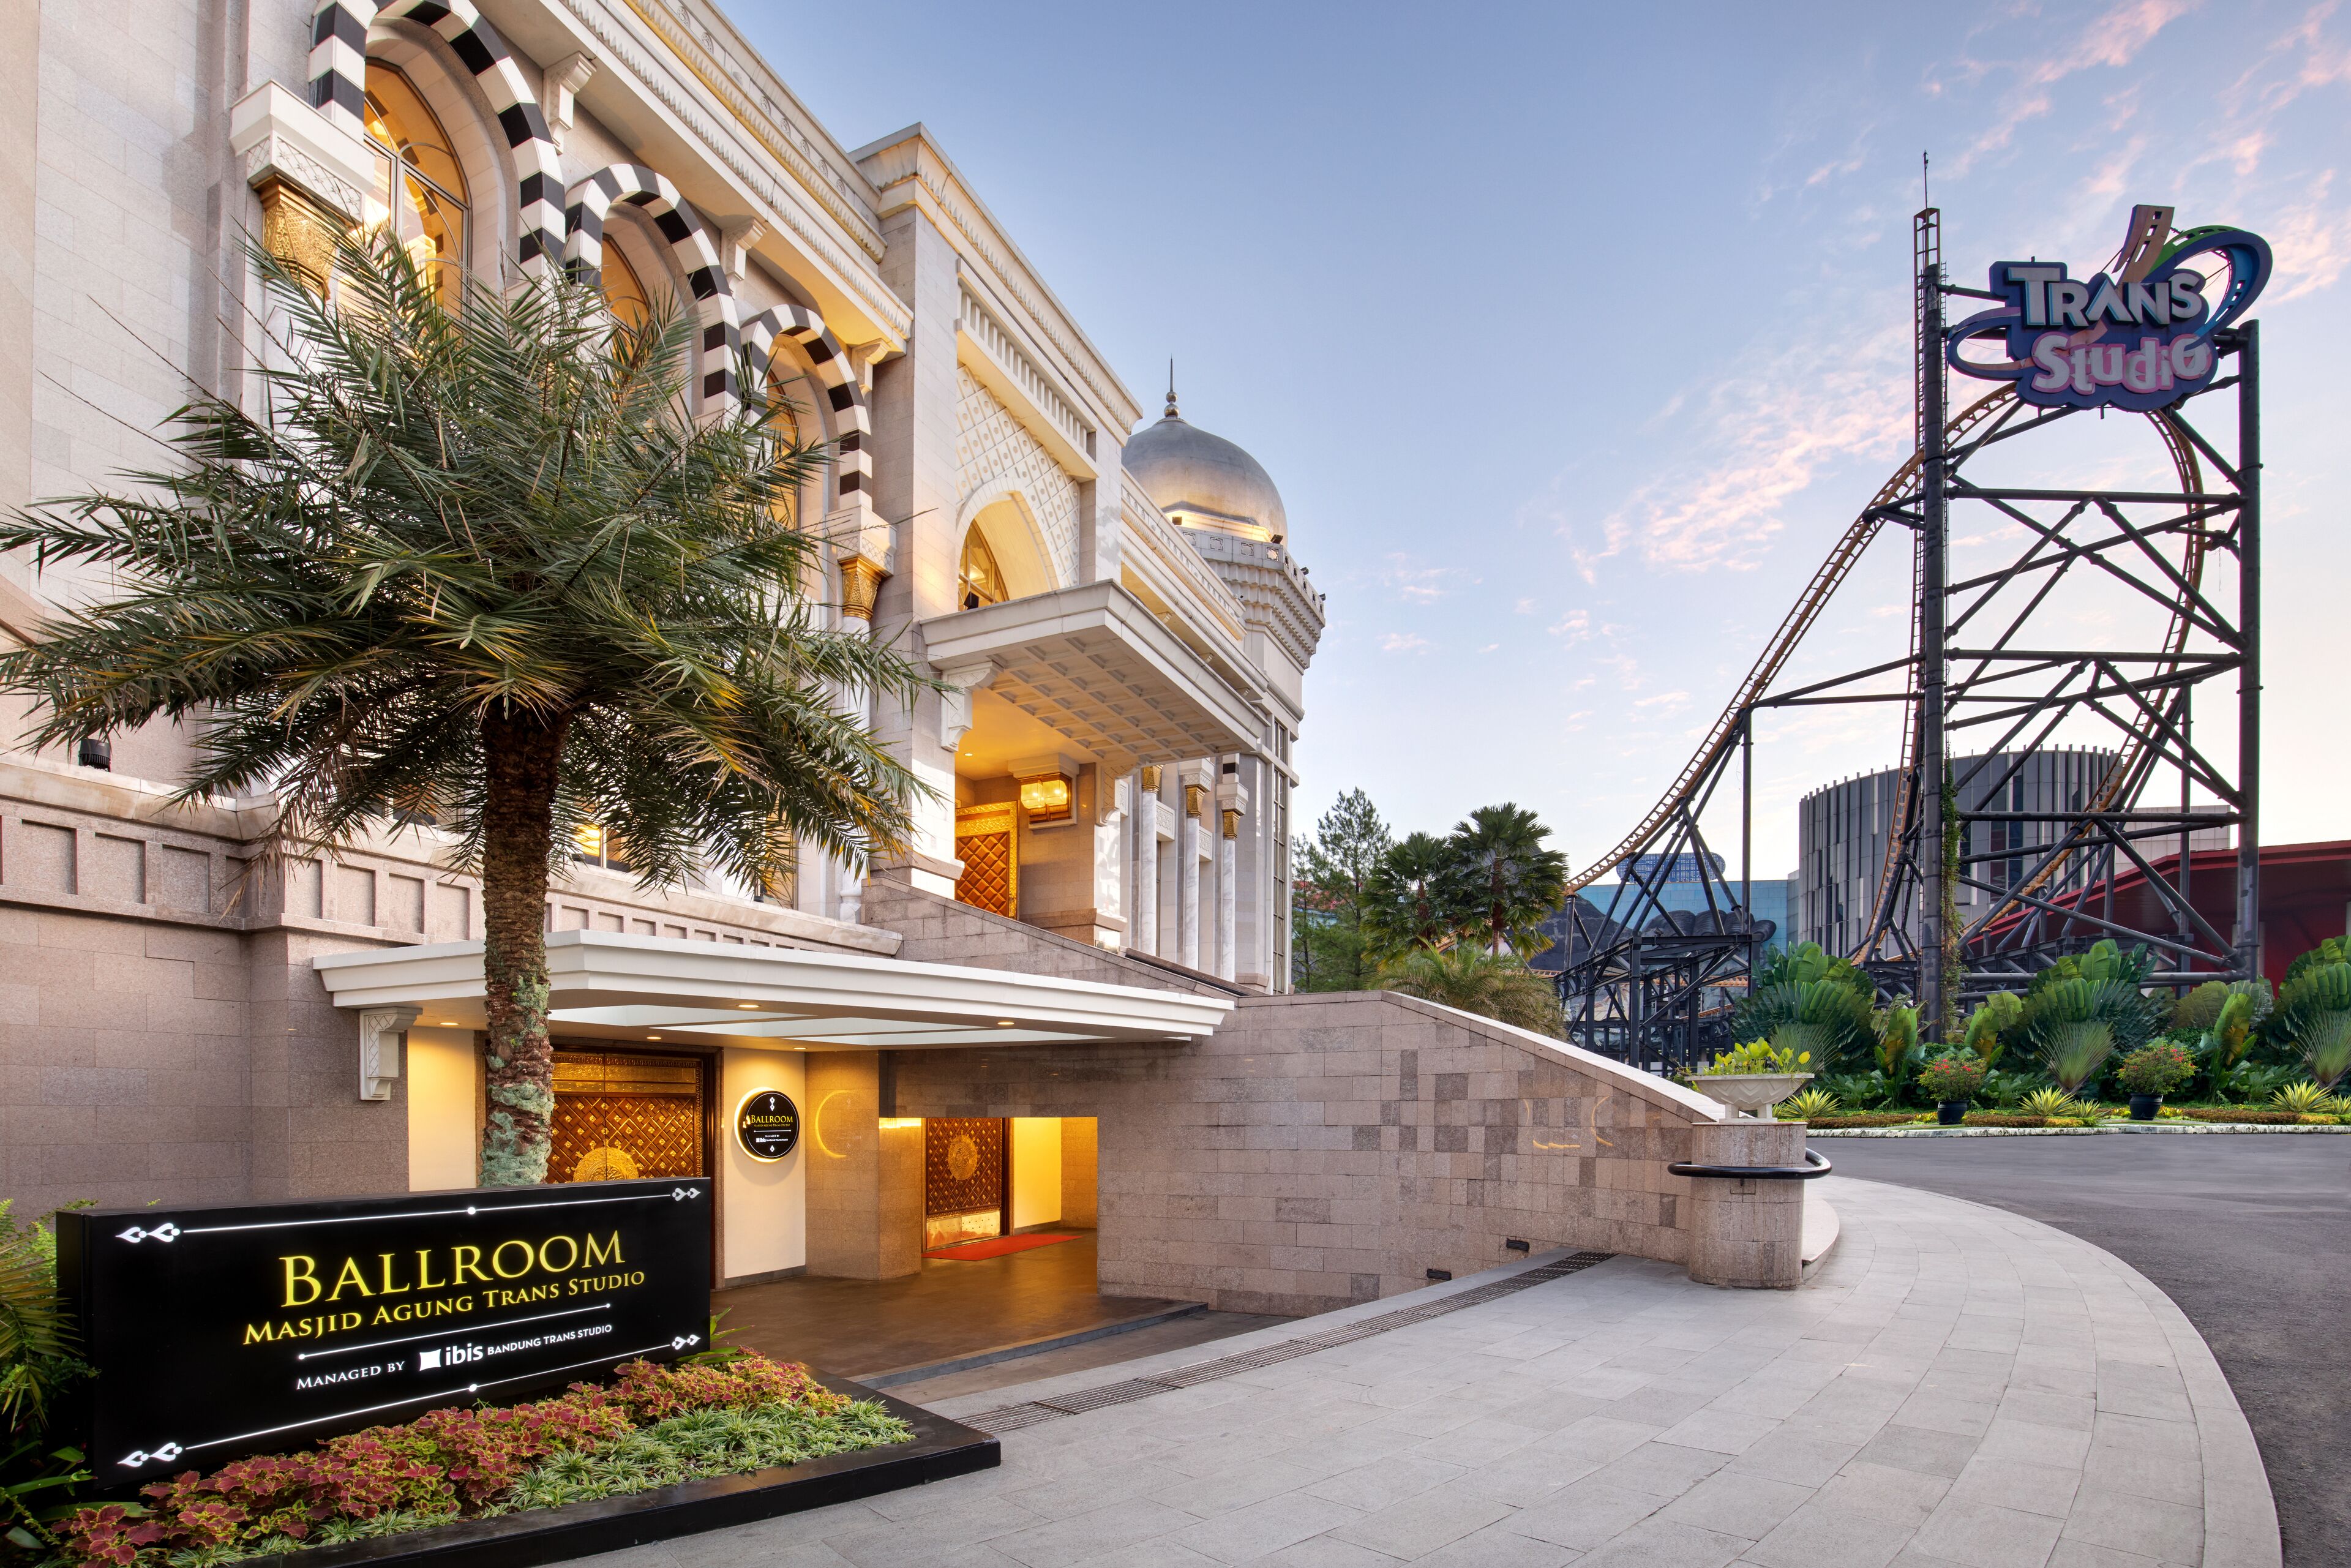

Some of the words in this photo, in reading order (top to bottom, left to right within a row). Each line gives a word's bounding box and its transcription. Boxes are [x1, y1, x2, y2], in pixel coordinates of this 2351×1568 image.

[2008, 267, 2203, 328] TRANS
[2032, 332, 2212, 394] Studio
[751, 1114, 793, 1123] BALLROOM
[279, 1230, 626, 1307] BALLROOM
[242, 1312, 362, 1345] MASJID
[371, 1296, 473, 1326] AGUNG
[482, 1283, 559, 1308] TRANS
[568, 1271, 645, 1296] STUDIO
[296, 1365, 381, 1390] MANAGED
[387, 1360, 405, 1373] BY
[446, 1342, 484, 1366] ibis
[487, 1338, 541, 1356] BANDUNG
[542, 1331, 576, 1345] TRANS
[577, 1324, 612, 1338] STUDIO
